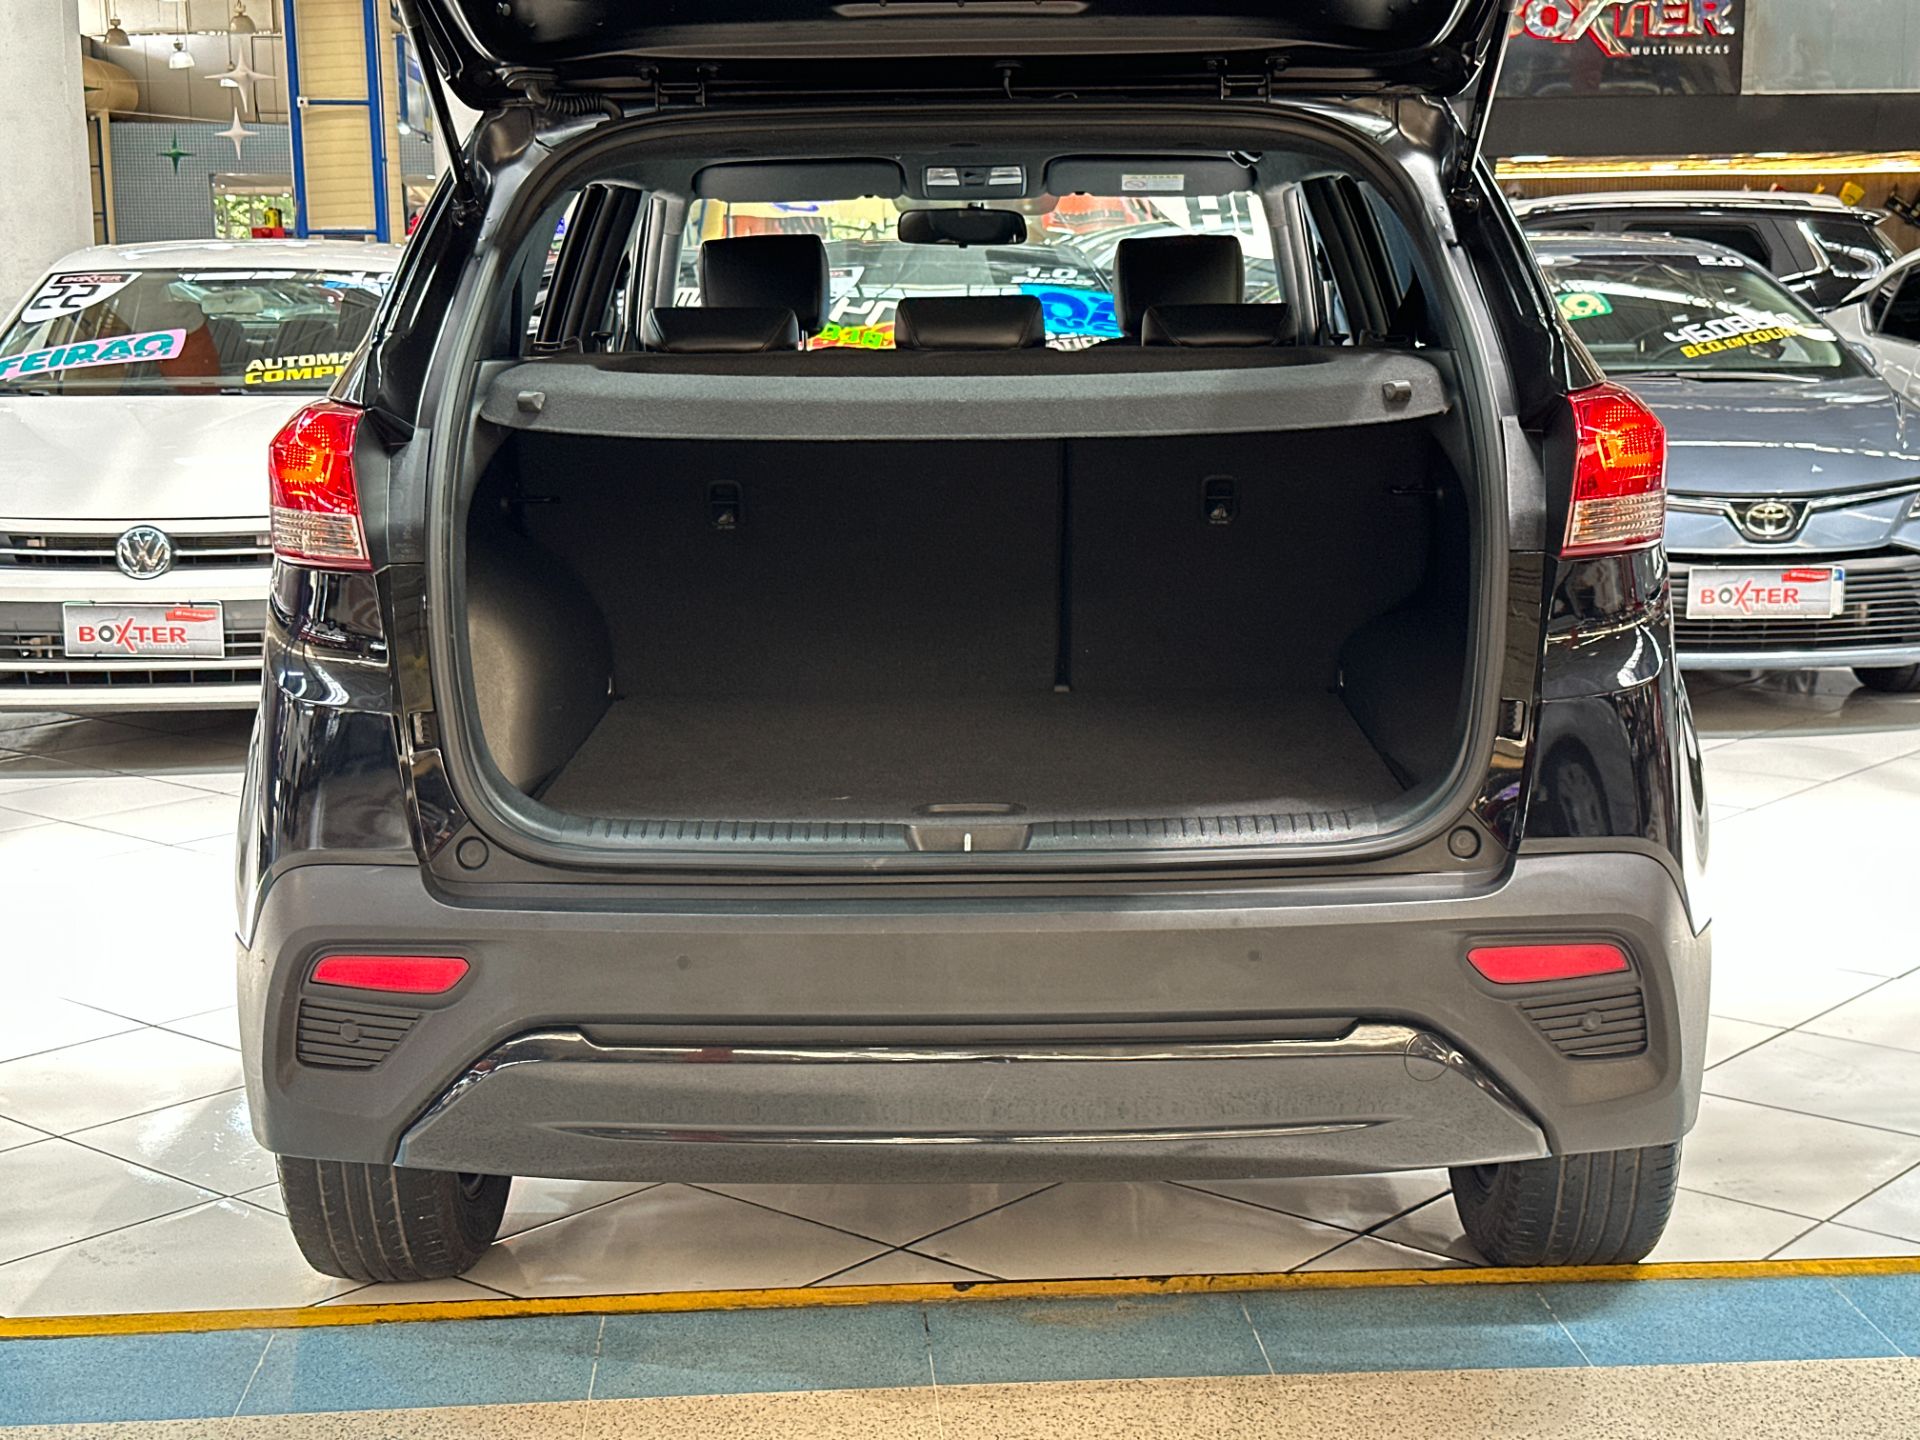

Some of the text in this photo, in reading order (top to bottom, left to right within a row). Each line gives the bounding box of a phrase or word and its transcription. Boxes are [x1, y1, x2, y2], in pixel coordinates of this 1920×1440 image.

[1631, 45, 1730, 56] MULTIMARCAS
[1697, 255, 1745, 267] 2.0
[61, 274, 122, 284] BOXTER
[30, 285, 101, 309] 22
[0, 333, 174, 376] FEIRÃO
[1700, 579, 1799, 613] BOXTER
[78, 617, 189, 653] BOXTER
